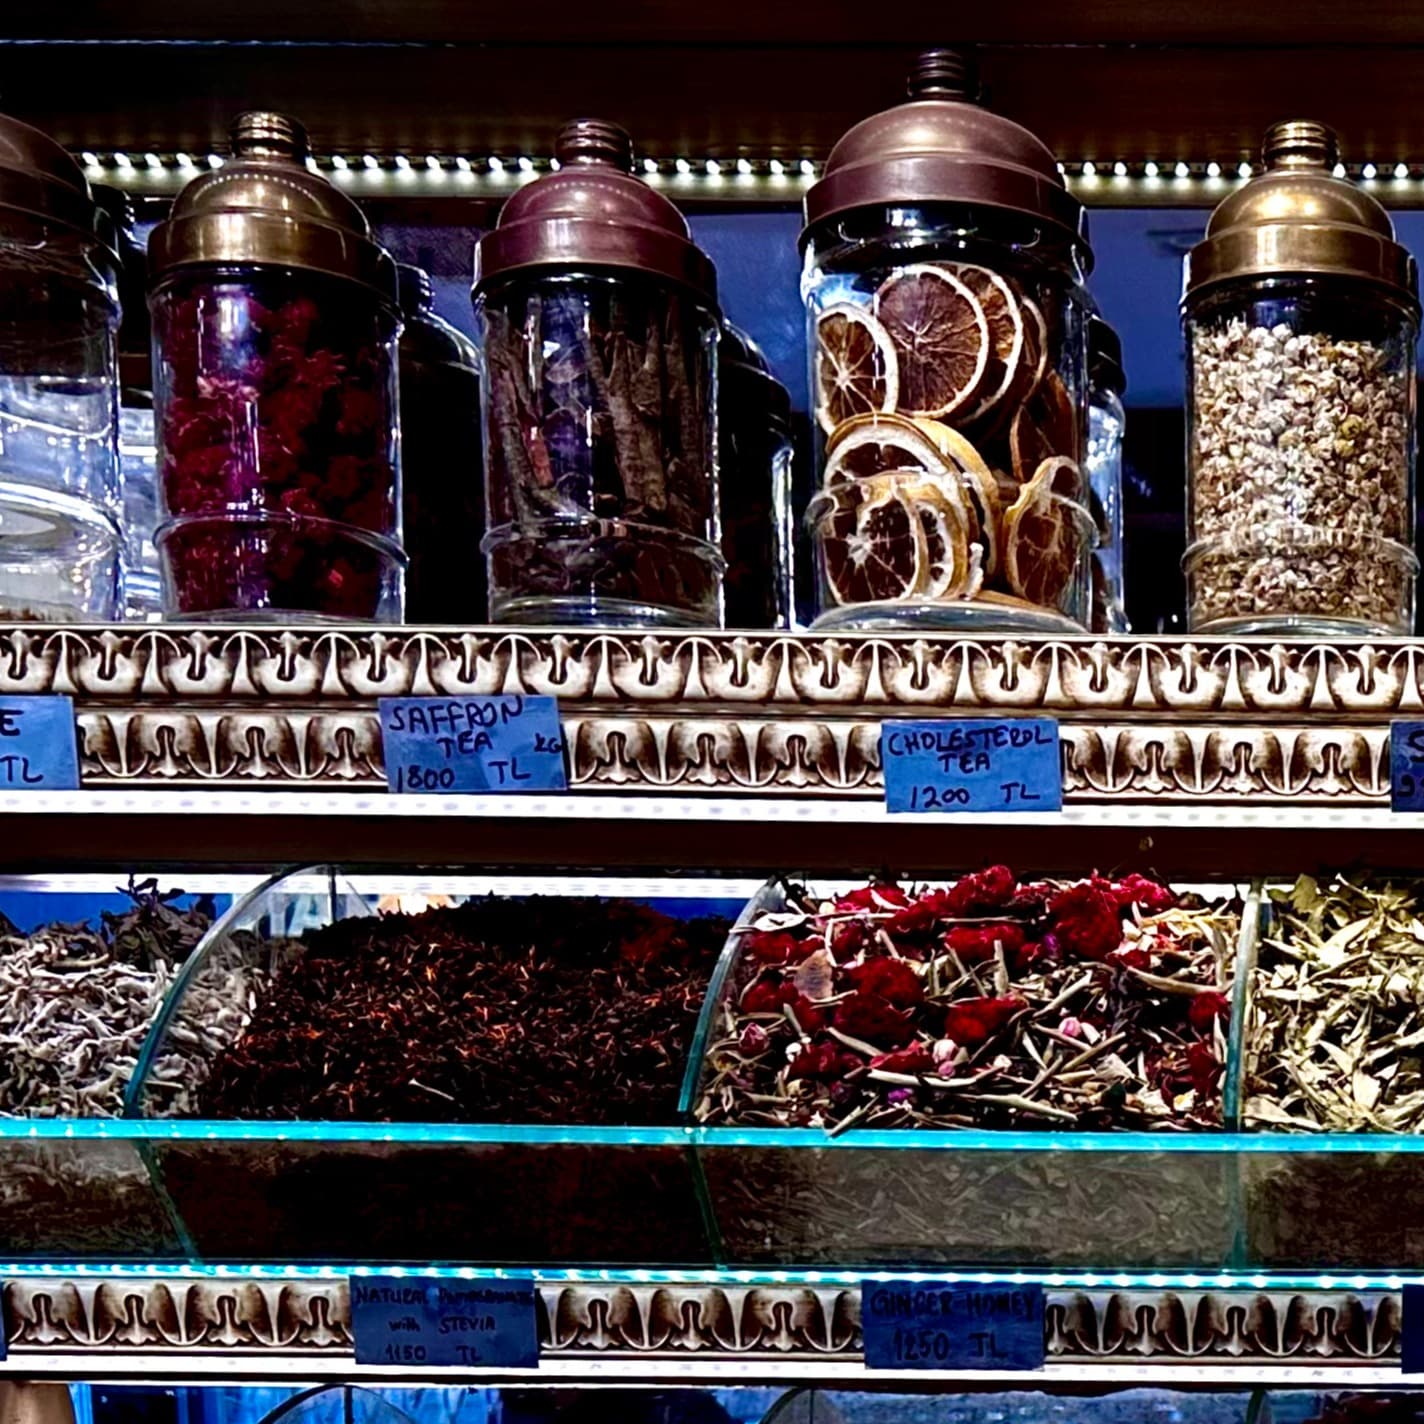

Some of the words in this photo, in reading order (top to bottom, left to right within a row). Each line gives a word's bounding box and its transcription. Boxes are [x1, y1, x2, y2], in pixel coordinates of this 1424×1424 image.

[388, 695, 523, 735] SAFFRON
[436, 730, 494, 759] TEA
[888, 725, 1053, 756] CHOLESTEROL
[397, 764, 456, 794] 1800
[488, 757, 533, 785] TL
[938, 752, 991, 774] TEA
[911, 785, 970, 809] 1200
[1000, 782, 1041, 804] TL
[438, 1316, 496, 1334] STEVIA
[385, 1344, 427, 1361] 1150
[455, 1345, 483, 1362] TL
[895, 1328, 950, 1361] 1250
[968, 1332, 1009, 1359] TL
